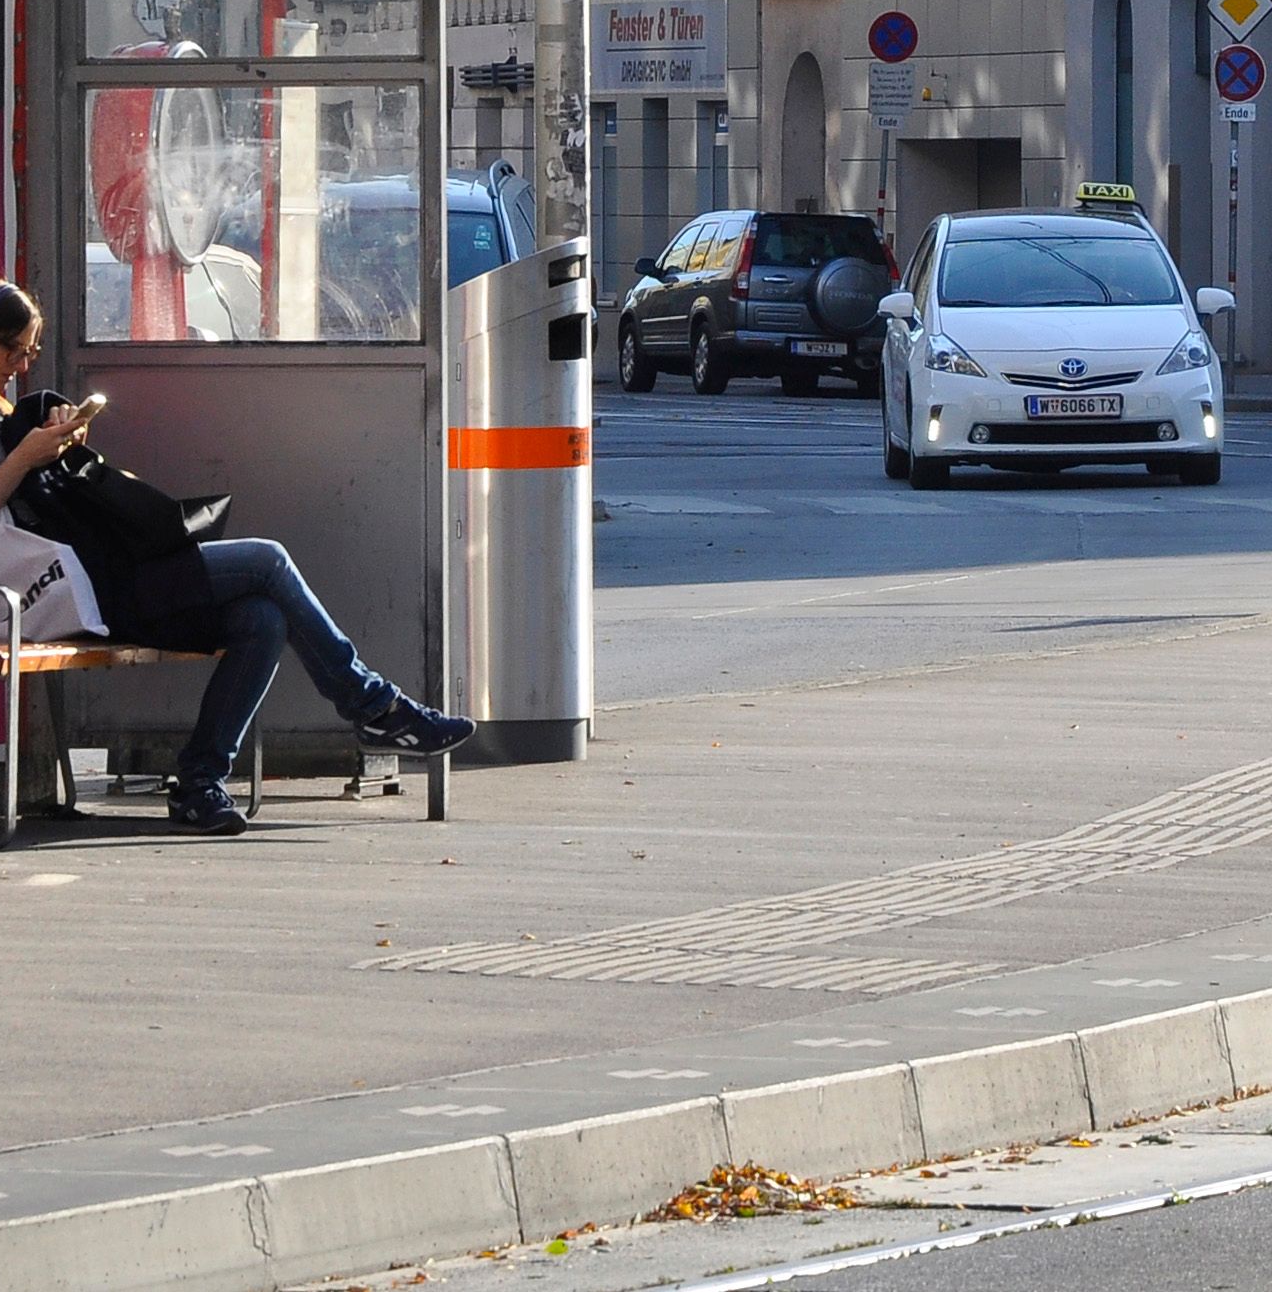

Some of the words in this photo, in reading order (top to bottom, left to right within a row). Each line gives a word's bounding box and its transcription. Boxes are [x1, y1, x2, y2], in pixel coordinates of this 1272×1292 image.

[608, 9, 655, 43] Fenster
[657, 7, 667, 42] &
[670, 7, 704, 41] Türen
[669, 58, 692, 82] GmbH
[1224, 107, 1249, 119] Ende
[878, 116, 898, 127] Ende
[1085, 185, 1127, 197] TAXI
